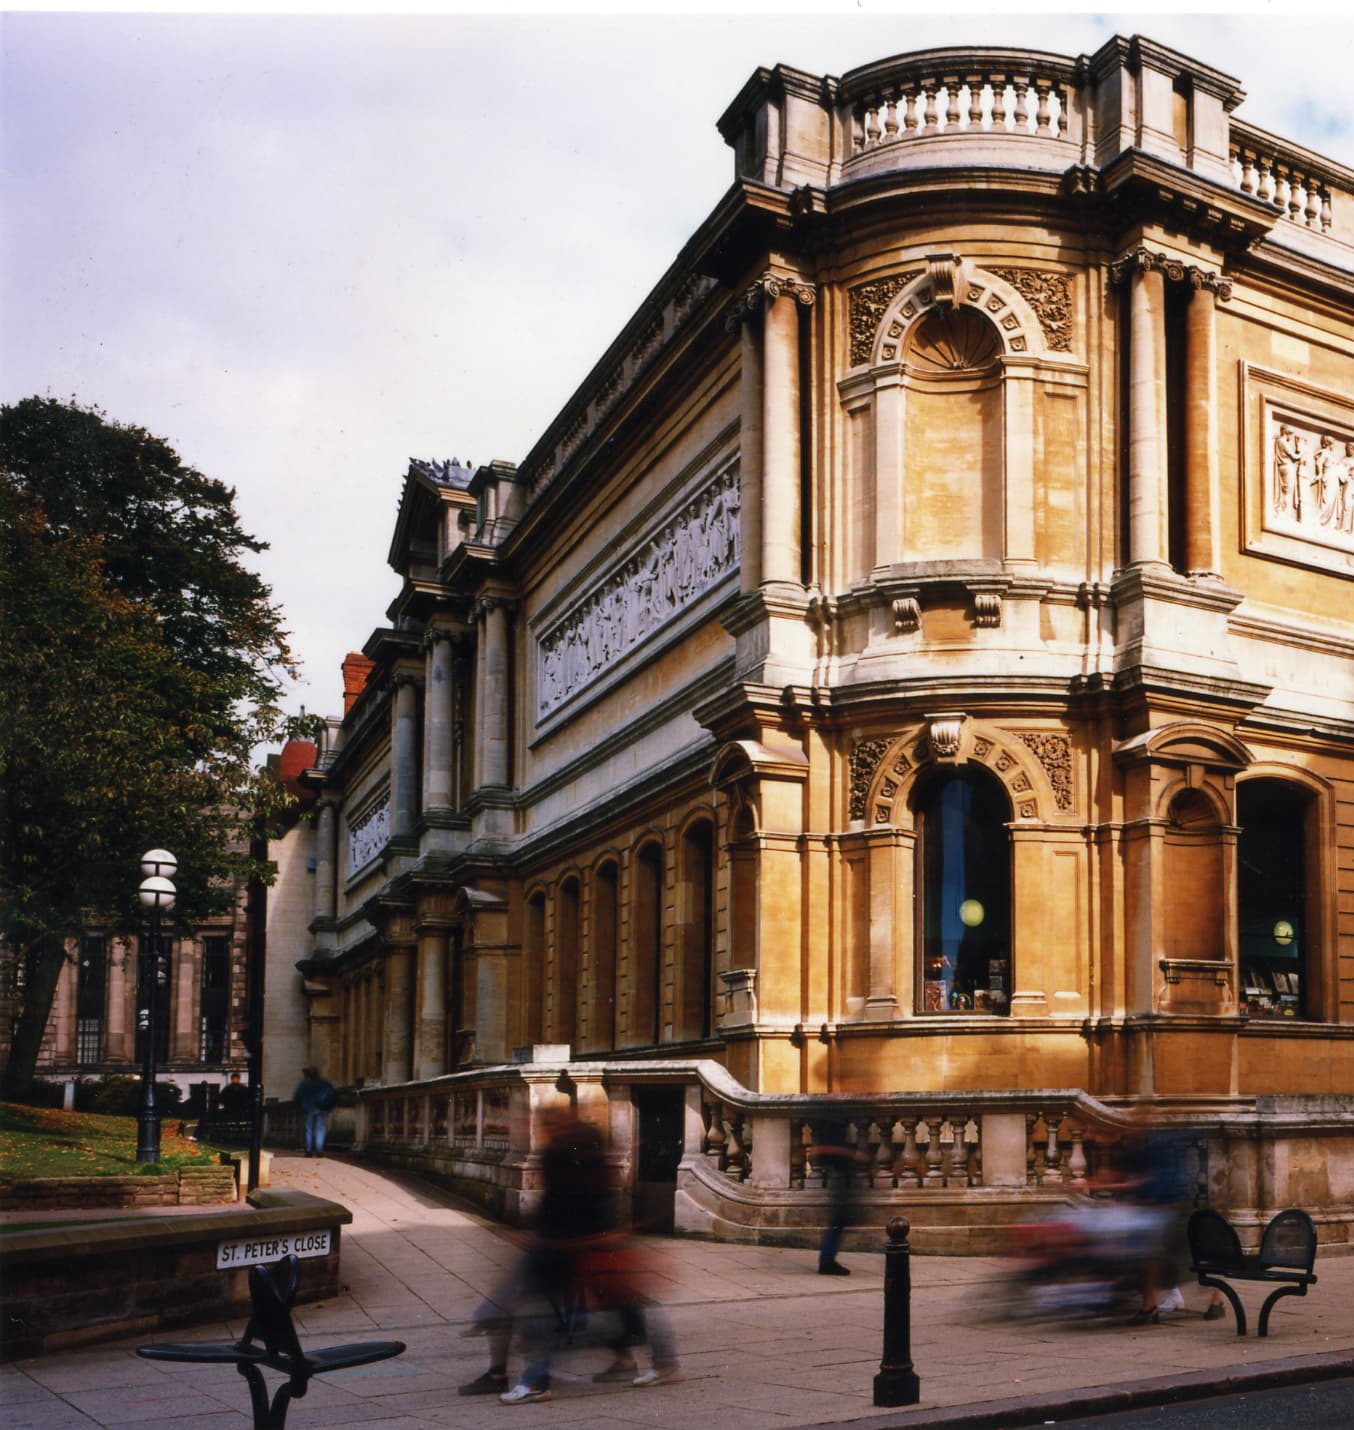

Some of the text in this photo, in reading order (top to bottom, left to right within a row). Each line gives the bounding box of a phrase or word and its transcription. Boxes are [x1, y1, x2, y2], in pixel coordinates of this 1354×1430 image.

[222, 1234, 327, 1262] ST. PETER'S CLOSE
